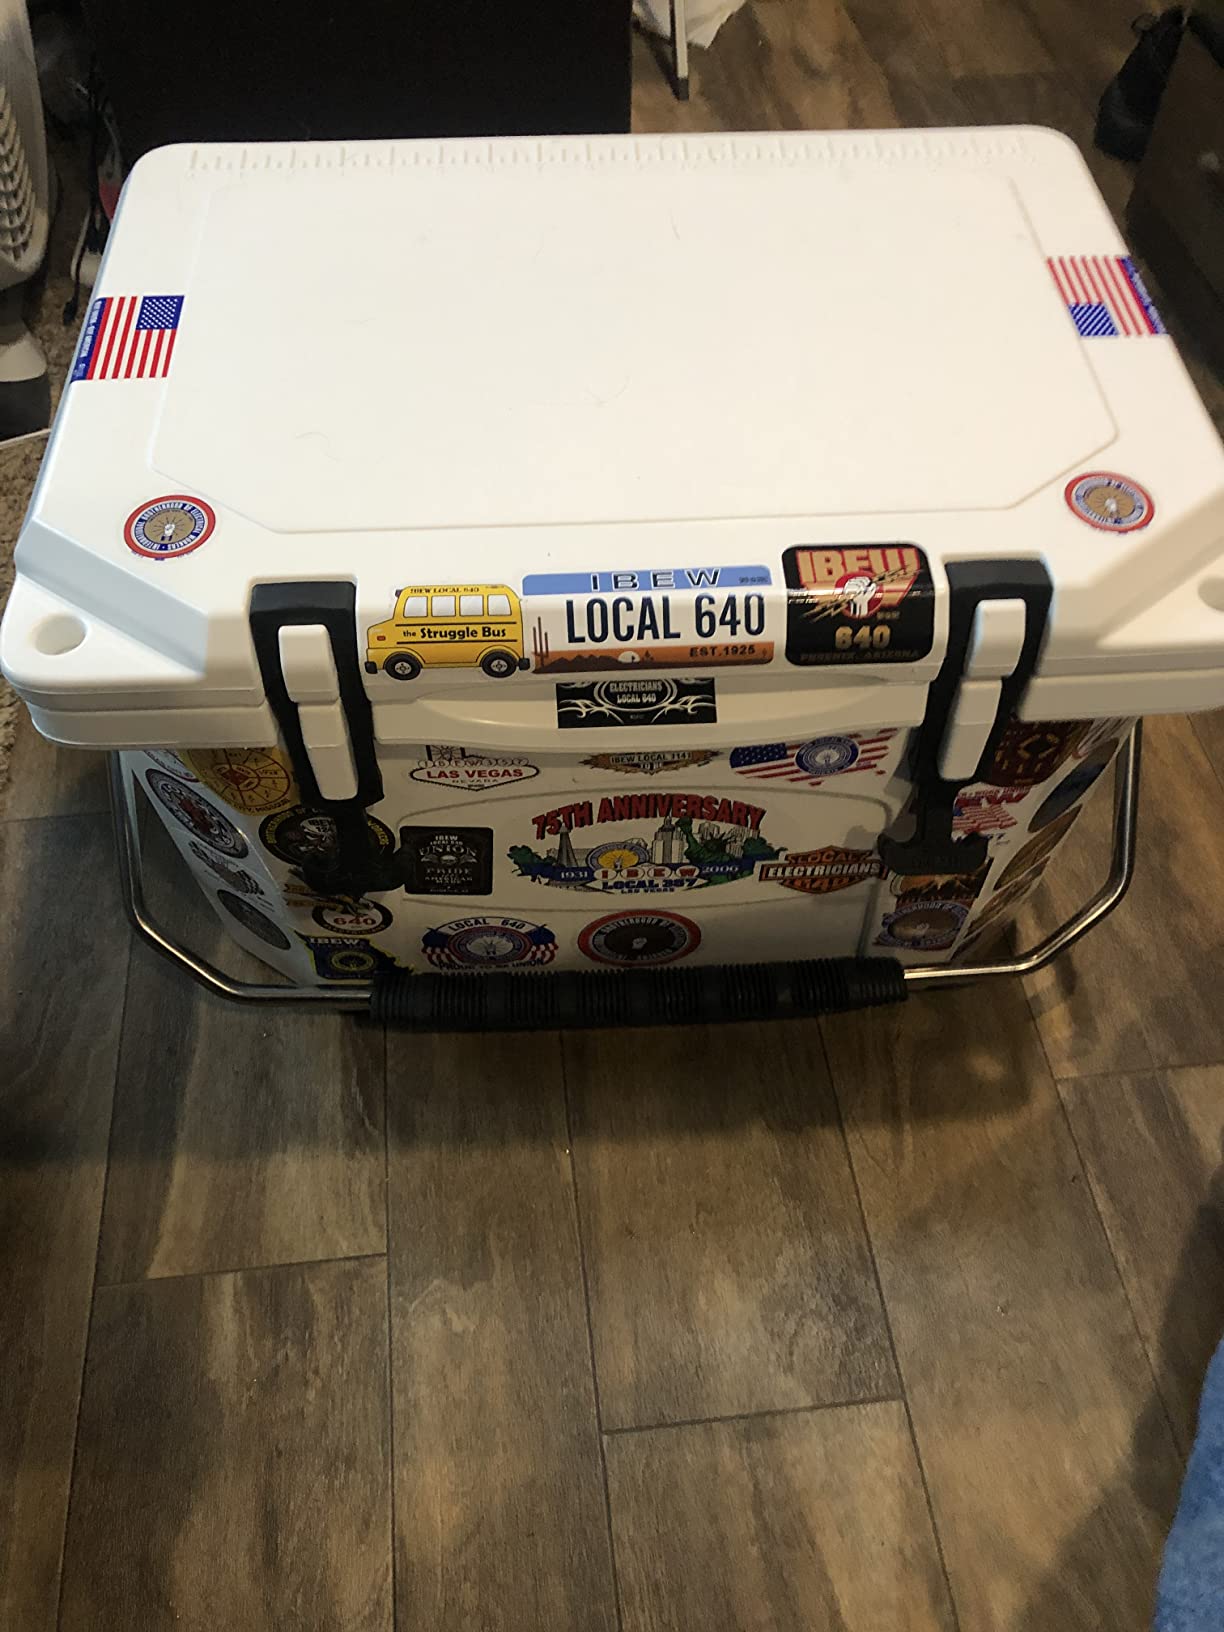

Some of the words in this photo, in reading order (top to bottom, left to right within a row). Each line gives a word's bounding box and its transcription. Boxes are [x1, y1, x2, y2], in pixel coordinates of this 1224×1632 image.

[590, 568, 721, 591] IBEW
[565, 593, 681, 644] LOCAL
[694, 592, 765, 638] 640
[420, 626, 478, 640] Struggle
[482, 626, 506, 638] Bus
[835, 624, 891, 649] 640
[609, 680, 663, 693] ELECTRICIANS
[617, 693, 641, 704] LOCAL
[638, 753, 668, 762] LOCAL
[427, 770, 460, 779] LAS
[465, 768, 524, 779] VEGAS
[531, 800, 594, 840] 75TH
[597, 793, 767, 831] ANNIVERSARY
[559, 870, 589, 880] 1931
[600, 867, 697, 878] IBEW
[701, 864, 740, 874] 2006
[768, 862, 881, 878] ELECTRICIANS
[602, 880, 659, 890] LOCAL
[662, 877, 697, 888] 357
[333, 915, 376, 925] 640
[448, 918, 490, 932] LOCAL
[501, 919, 526, 930] 640
[310, 937, 360, 945] IBEW
